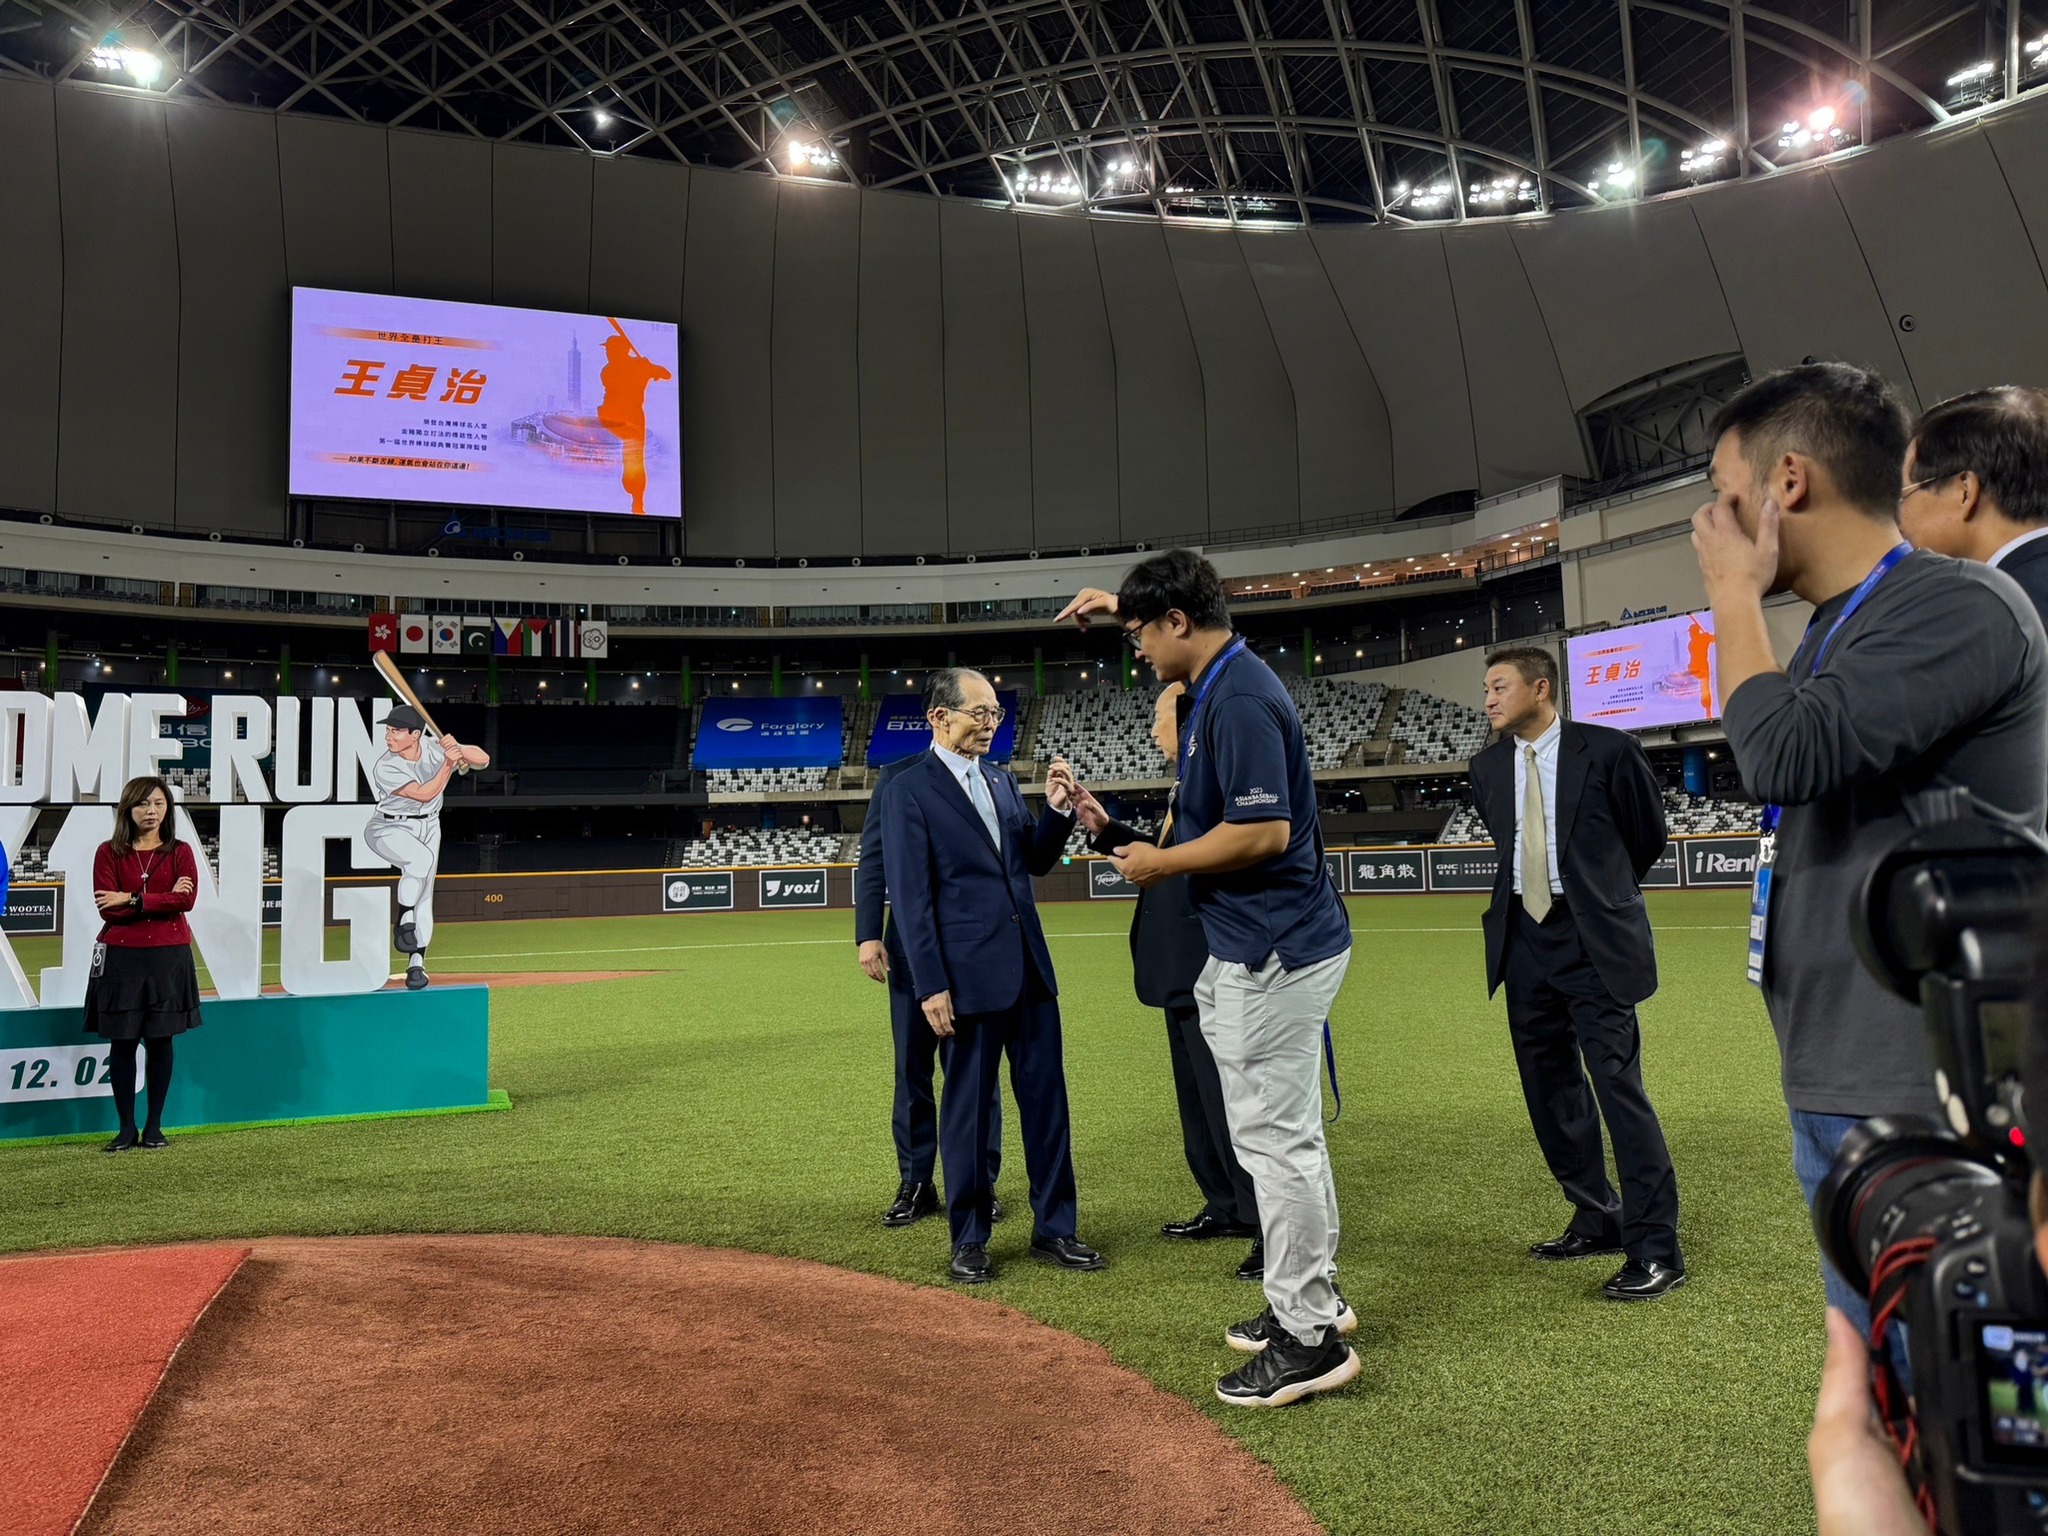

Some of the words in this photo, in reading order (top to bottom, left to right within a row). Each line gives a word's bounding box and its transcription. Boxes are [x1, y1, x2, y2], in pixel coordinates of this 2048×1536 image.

[378, 331, 443, 346] 世界全壘打王
[334, 358, 488, 405] 王貞治
[1585, 660, 1642, 686] 王貞治
[760, 722, 825, 731] Farglory
[211, 695, 394, 803] RUN
[1249, 786, 1263, 795] 2023
[1236, 799, 1279, 807] CHAMPIONSHIP
[1358, 863, 1417, 880] 龍角散
[783, 879, 820, 897] yoxi
[484, 893, 504, 903] 400
[9, 905, 52, 913] WOOTEA
